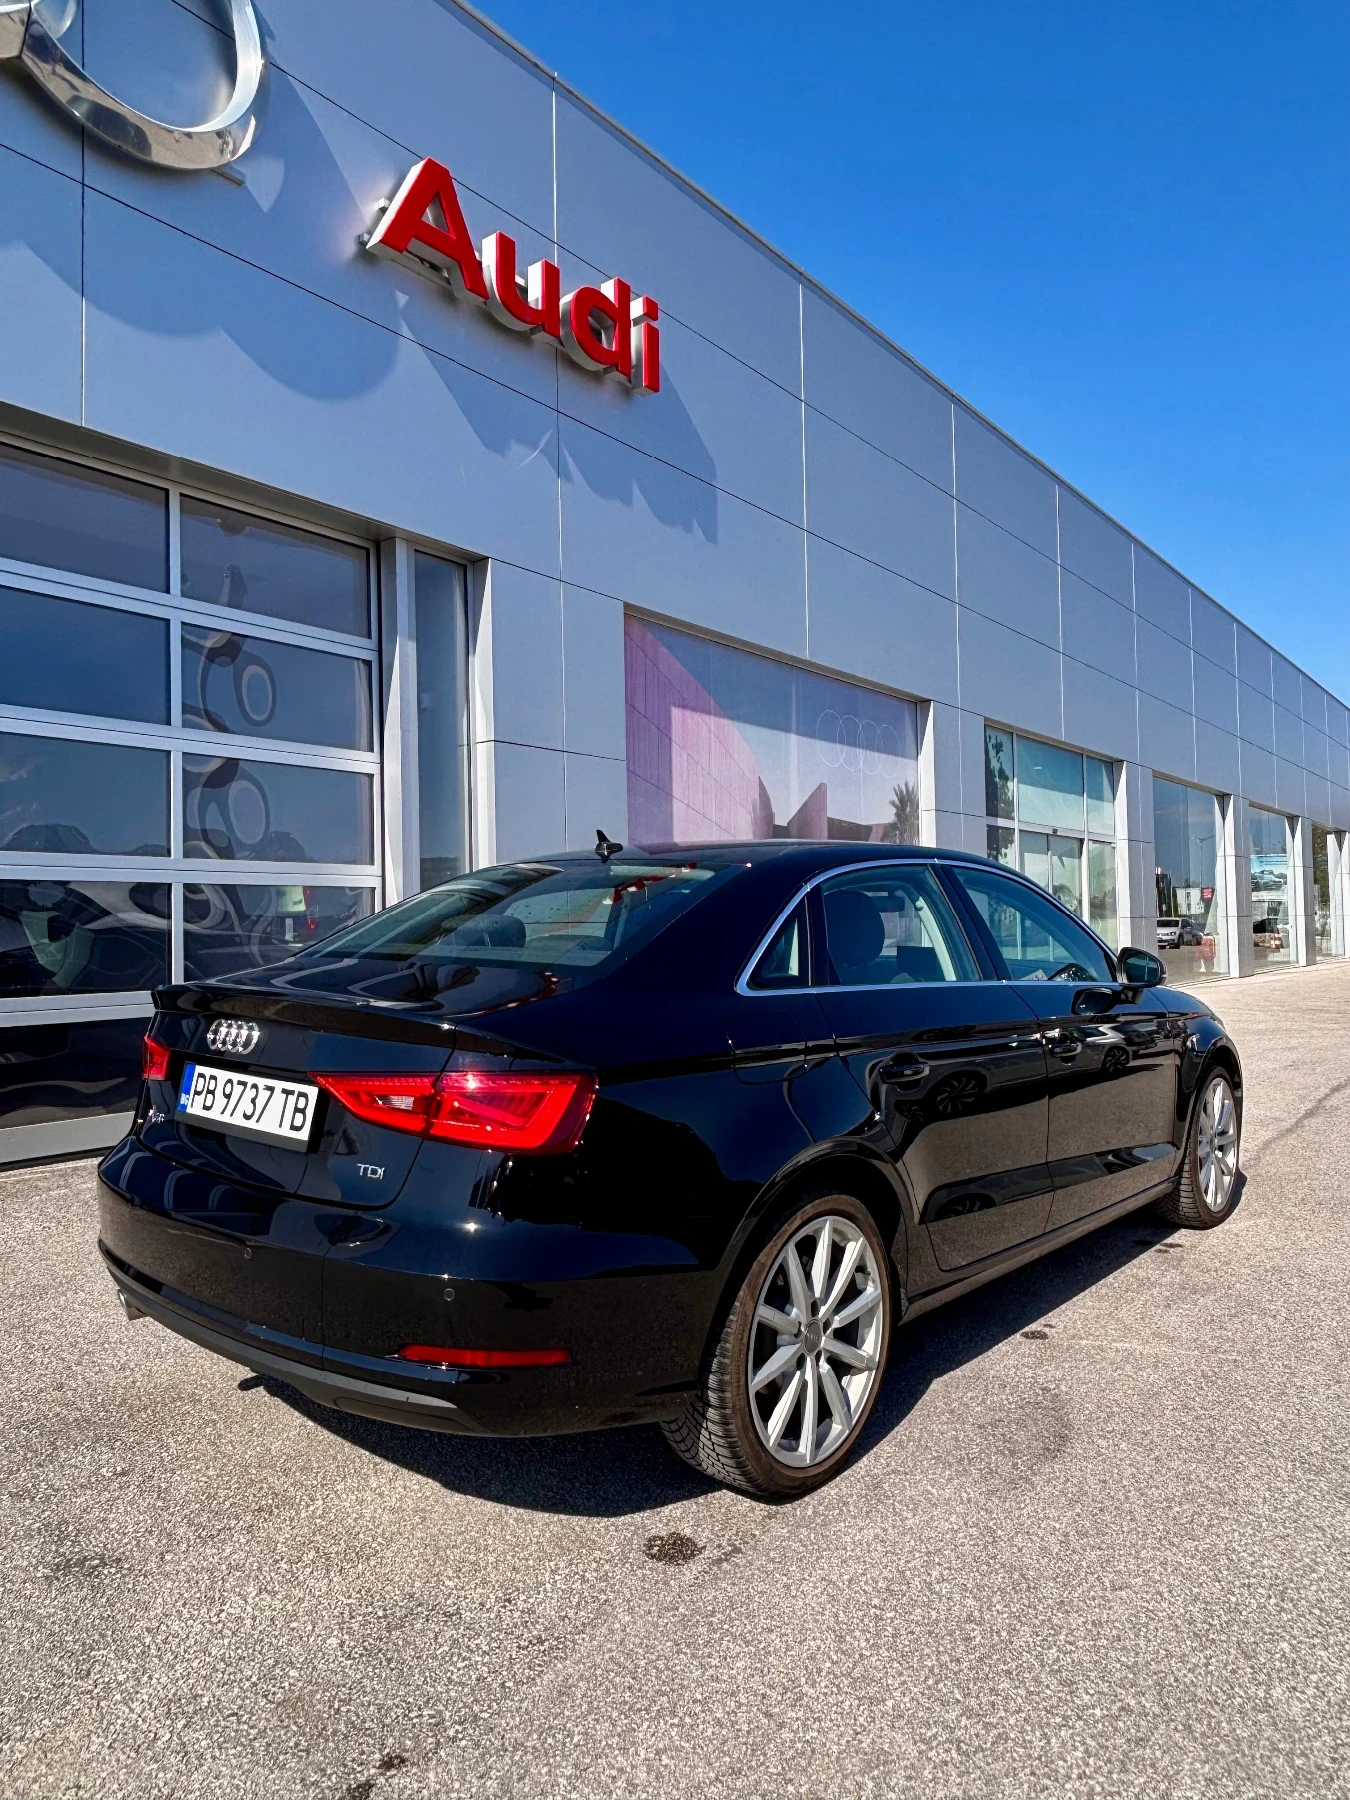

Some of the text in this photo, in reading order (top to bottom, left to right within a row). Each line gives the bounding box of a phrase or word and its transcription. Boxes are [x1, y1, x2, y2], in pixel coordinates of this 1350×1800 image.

[368, 156, 660, 394] Audi
[190, 1072, 310, 1132] PB 9737 TB
[356, 1163, 385, 1180] TDI
